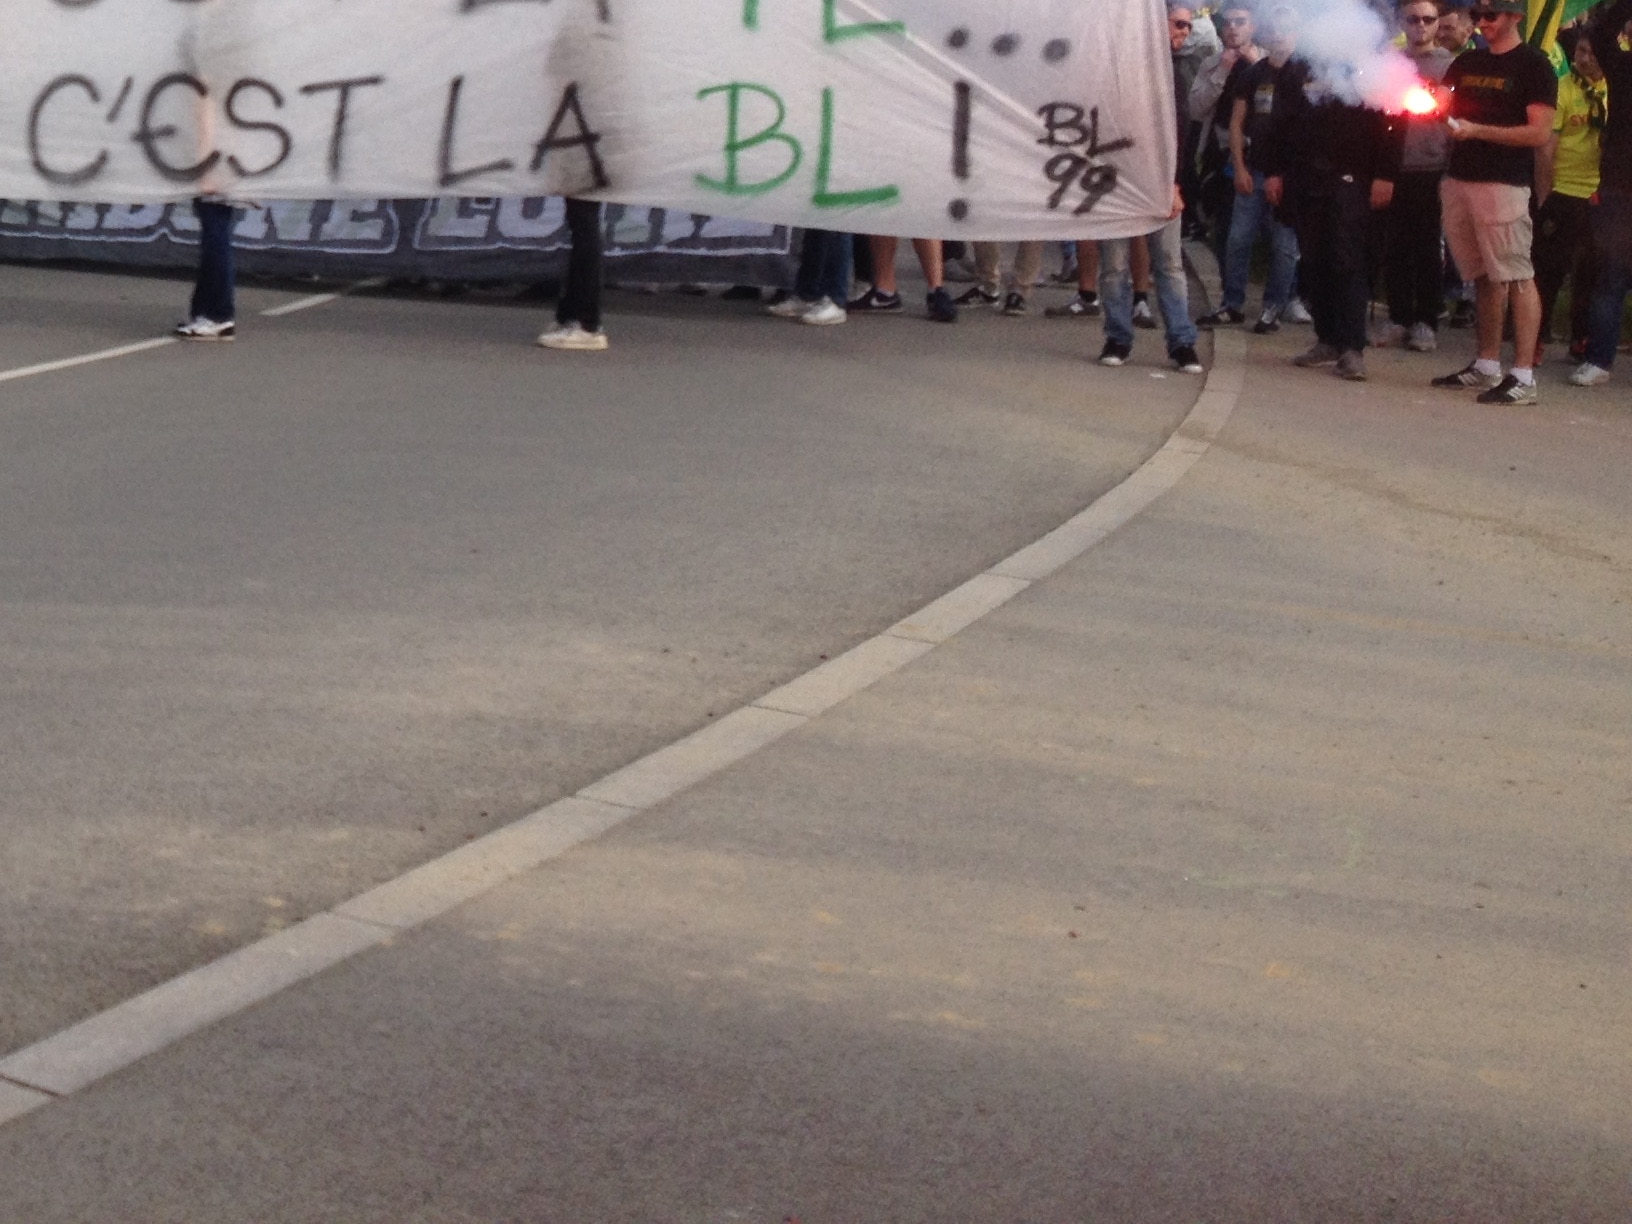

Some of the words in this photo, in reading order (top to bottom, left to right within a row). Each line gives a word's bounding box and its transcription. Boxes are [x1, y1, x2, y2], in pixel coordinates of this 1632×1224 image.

[28, 72, 382, 186] C'EST
[437, 75, 611, 189] LA
[1037, 102, 1135, 155] BL
[1042, 152, 1119, 216] 99
